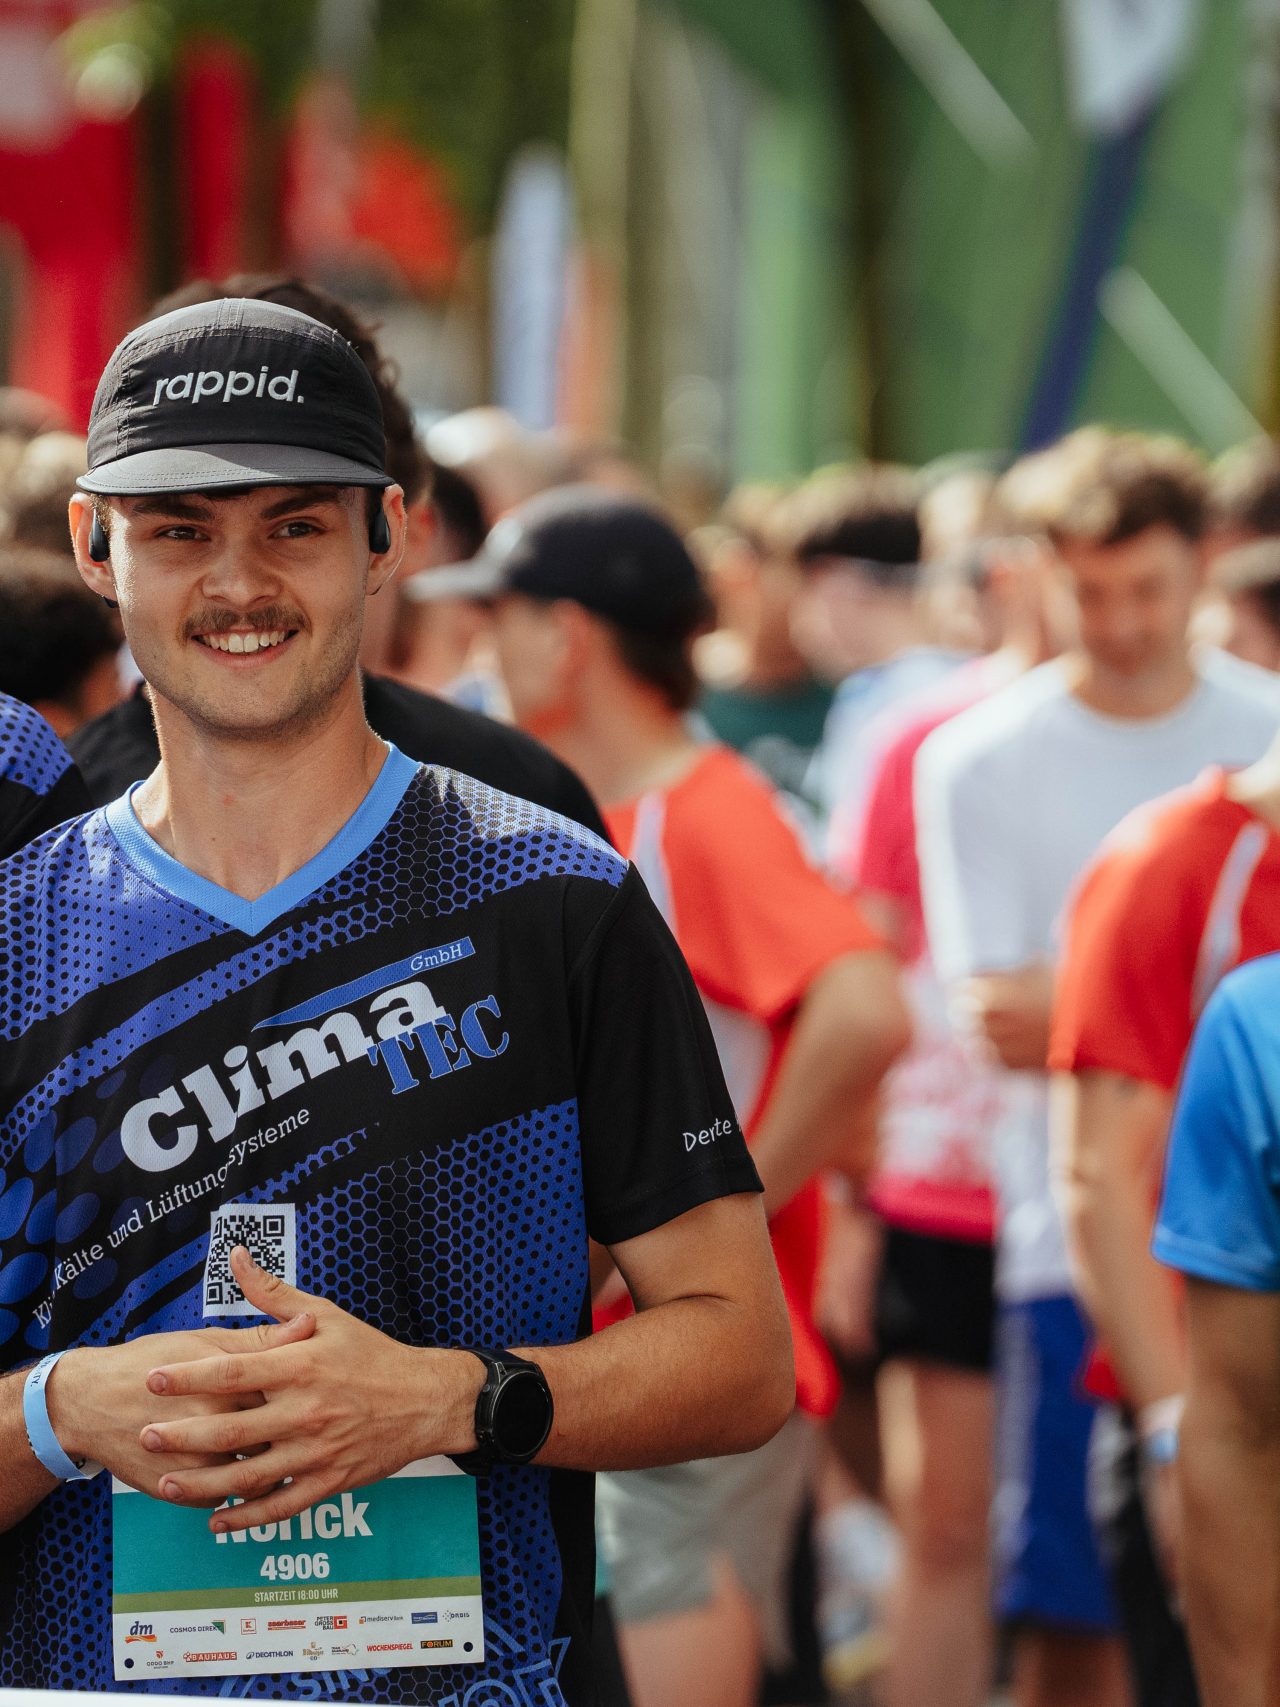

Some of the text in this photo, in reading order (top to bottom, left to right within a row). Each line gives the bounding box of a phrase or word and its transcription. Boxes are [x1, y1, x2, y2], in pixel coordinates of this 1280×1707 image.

[152, 365, 305, 406] rappid.
[409, 942, 463, 972] GmbH
[369, 994, 510, 1095] TEC
[120, 981, 447, 1172] Clima
[682, 1117, 733, 1152] Derte
[54, 1243, 105, 1291] Kälte
[107, 1208, 144, 1249] und
[260, 1553, 330, 1581] 4906
[254, 1588, 339, 1603] STARTZEIT 18:00 UHR
[129, 1621, 153, 1635] dm
[170, 1626, 197, 1634] COSMOS
[366, 1642, 414, 1652] WOCHENSPIEGEL
[421, 1639, 453, 1648] FORUM
[191, 1652, 237, 1661] BAUHAUS
[255, 1651, 294, 1659] DECATHLON
